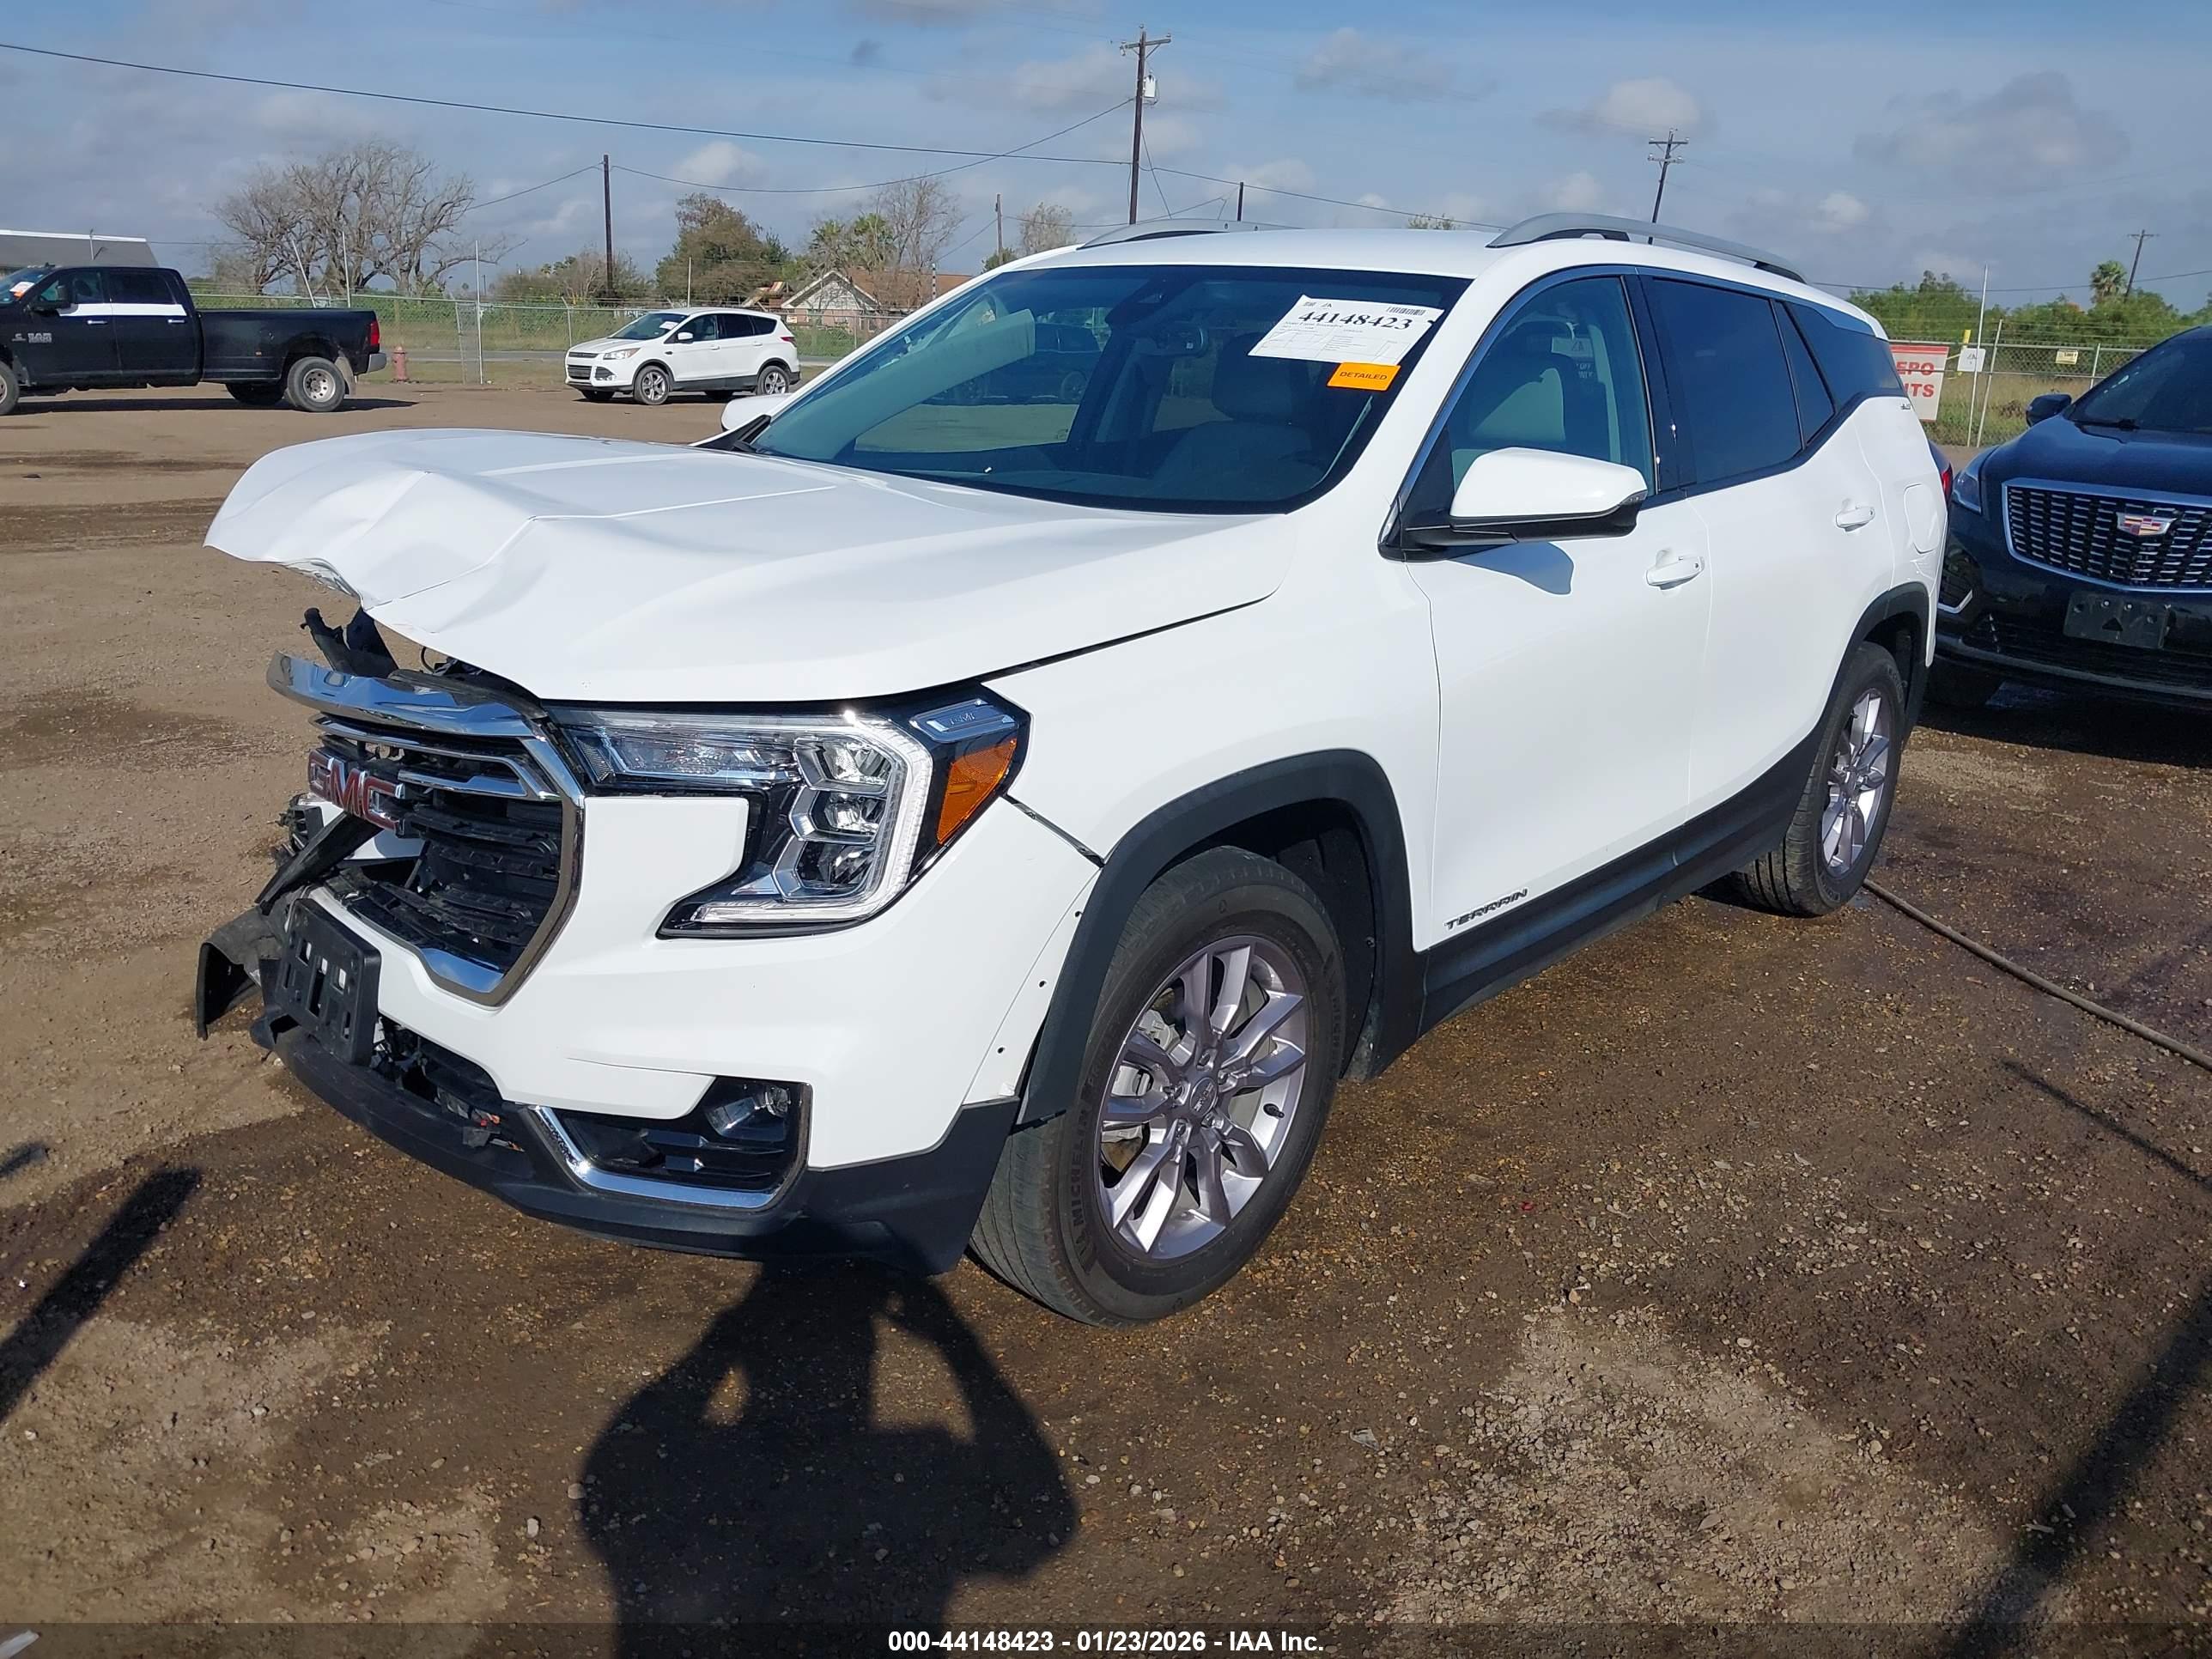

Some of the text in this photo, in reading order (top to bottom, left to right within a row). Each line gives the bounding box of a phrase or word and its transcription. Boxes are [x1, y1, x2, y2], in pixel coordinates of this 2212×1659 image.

[1298, 311, 1413, 330] 44148423
[1340, 371, 1388, 380] DETAILED
[1896, 362, 1935, 376] EPO
[307, 749, 406, 836] GMC
[1444, 888, 1528, 930] TERRAIN
[1071, 1109, 1090, 1226] MICHELIN
